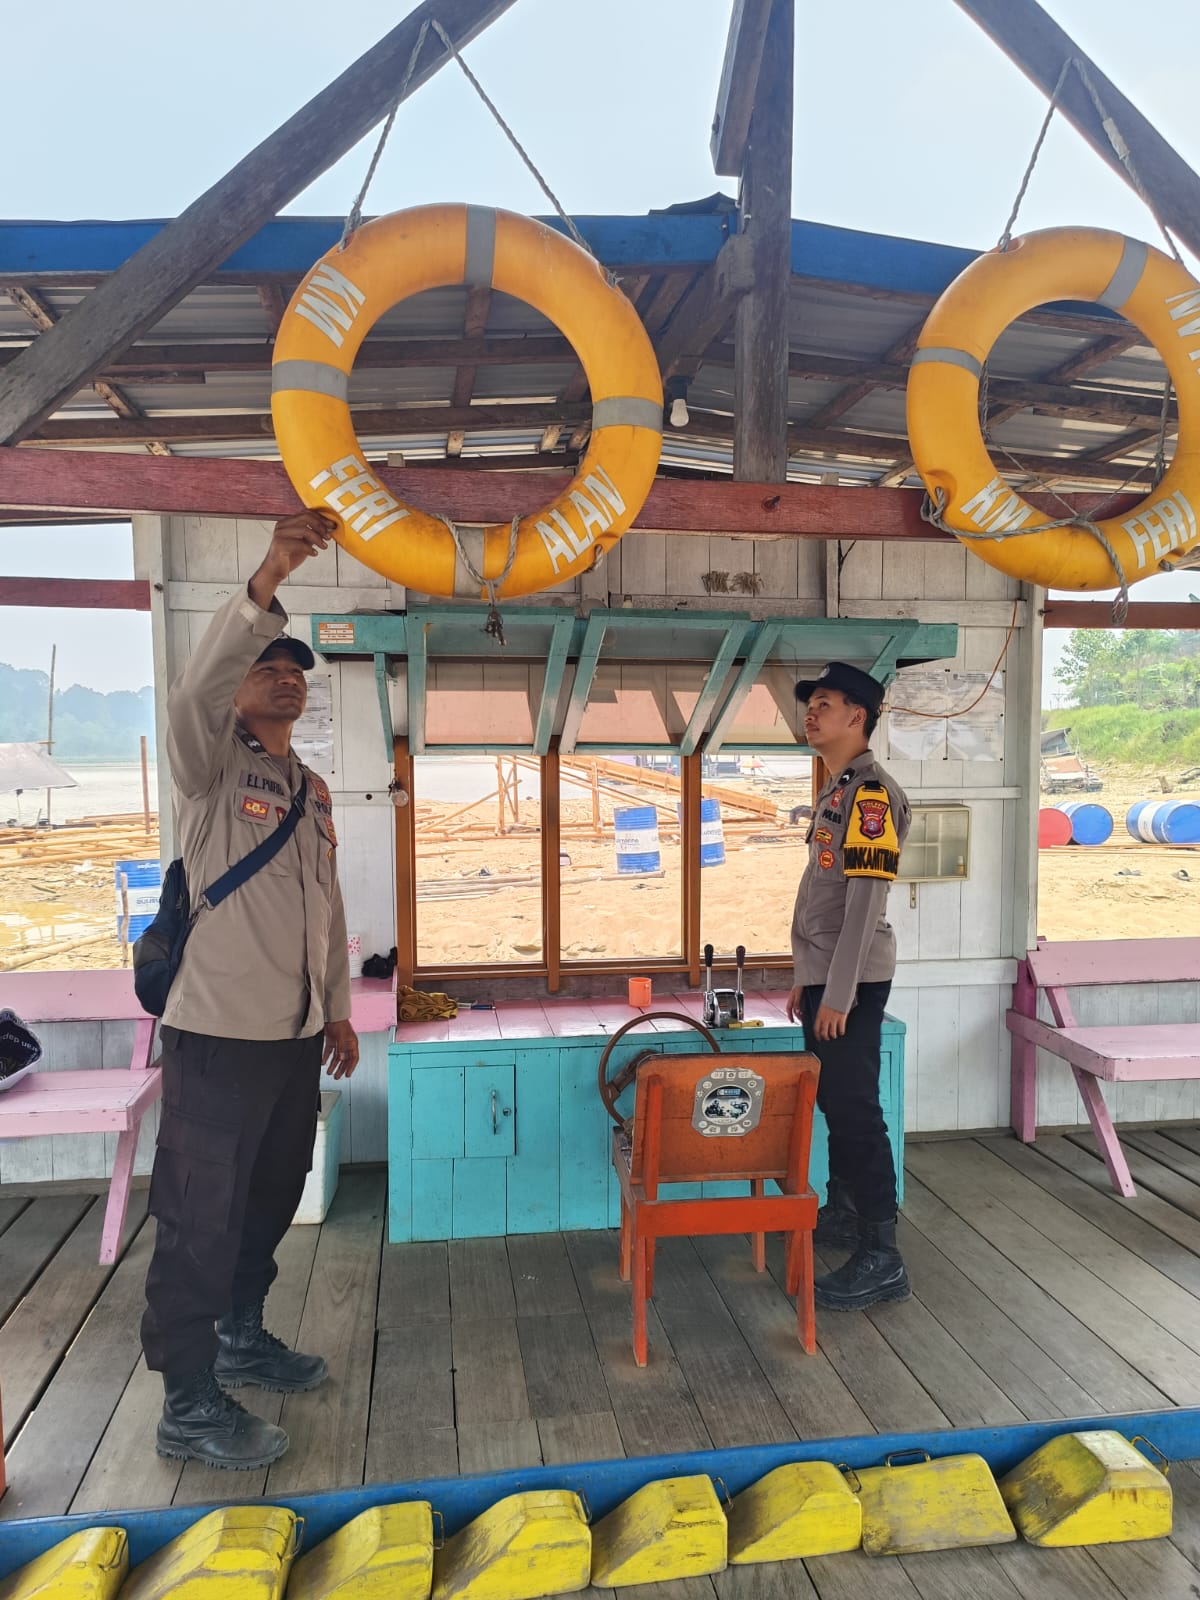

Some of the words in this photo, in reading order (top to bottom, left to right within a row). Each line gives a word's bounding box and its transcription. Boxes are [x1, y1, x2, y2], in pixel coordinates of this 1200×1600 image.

[308, 453, 412, 543] FERI
[533, 465, 628, 575] ALAN
[959, 476, 1034, 543] KM
[1121, 489, 1198, 570] FERI
